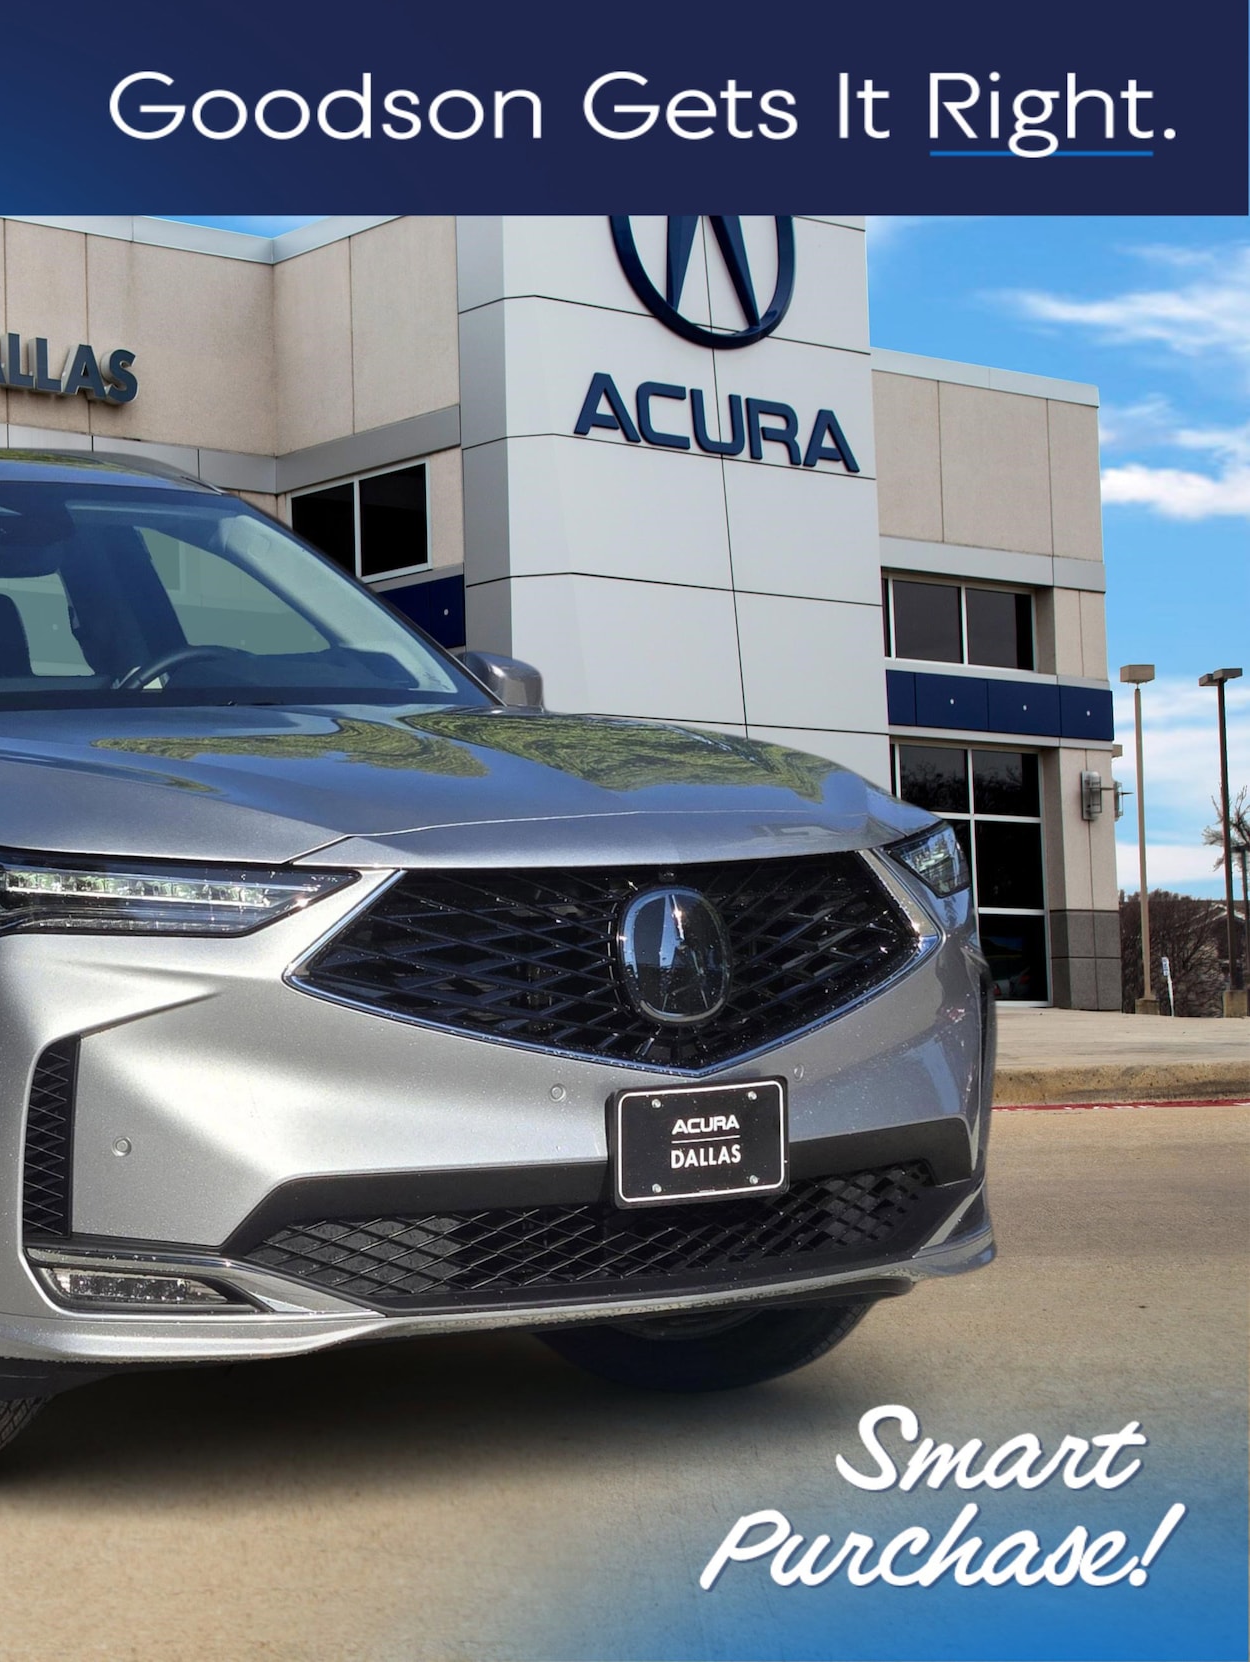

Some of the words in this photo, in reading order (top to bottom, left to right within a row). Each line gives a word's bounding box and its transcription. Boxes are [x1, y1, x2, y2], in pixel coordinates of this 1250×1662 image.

[573, 372, 860, 473] ACURA
[671, 1114, 741, 1135] ACURA
[670, 1144, 742, 1169] DALLAS
